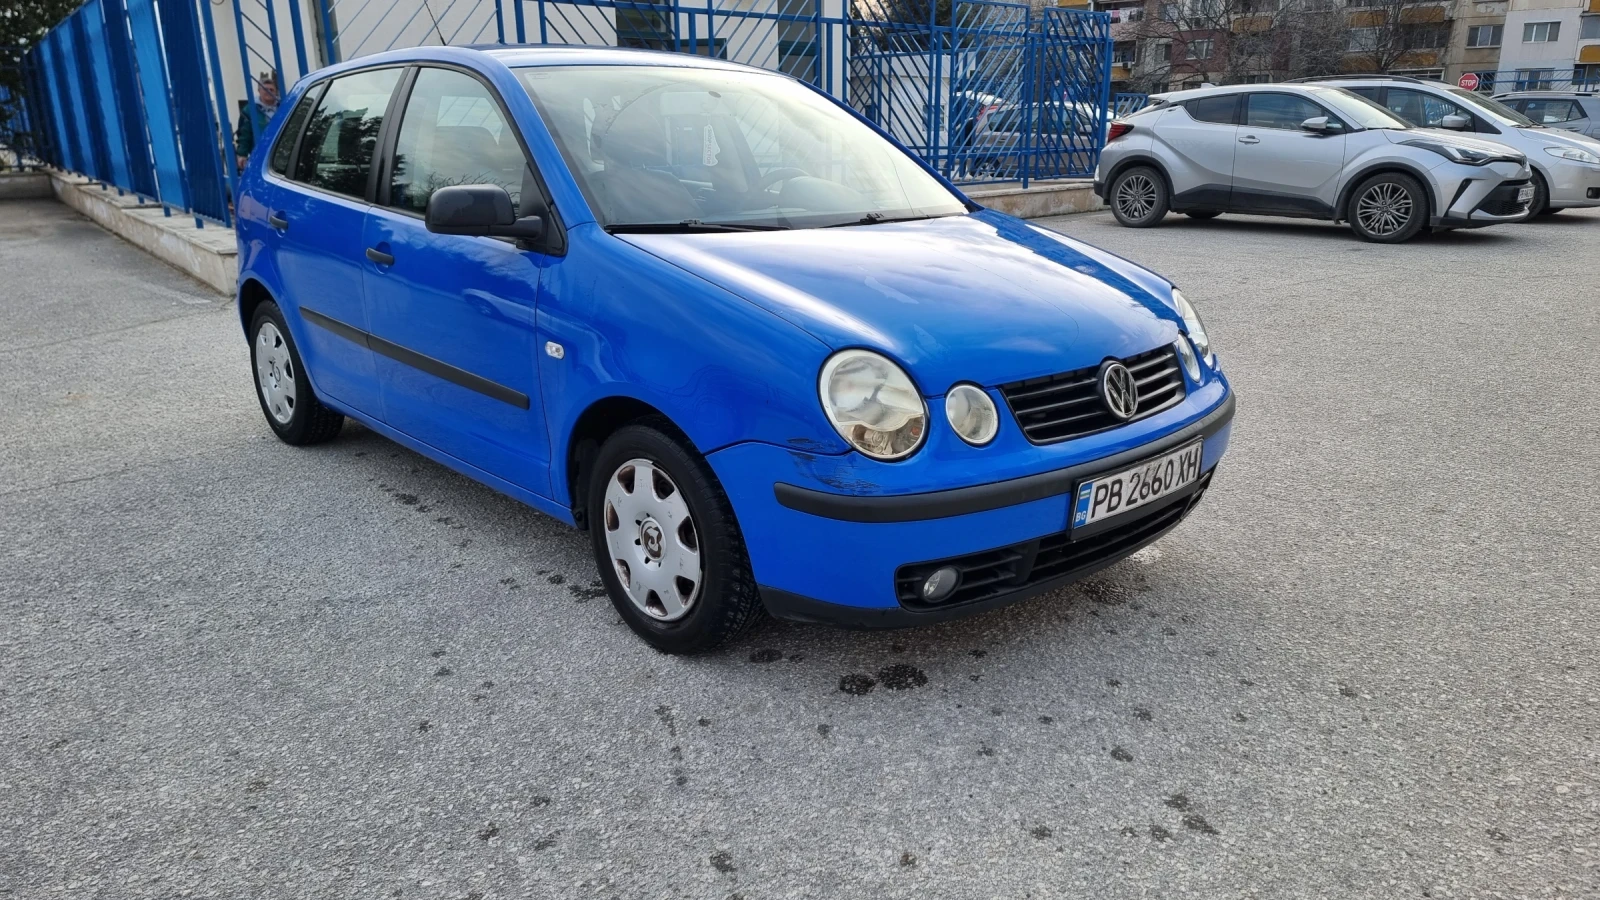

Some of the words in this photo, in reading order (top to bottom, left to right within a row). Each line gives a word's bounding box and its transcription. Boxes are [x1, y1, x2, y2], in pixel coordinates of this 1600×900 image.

[1090, 478, 1123, 519] PB
[1125, 458, 1175, 507] 2660
[1175, 447, 1199, 487] XH
[1075, 510, 1087, 523] BG
